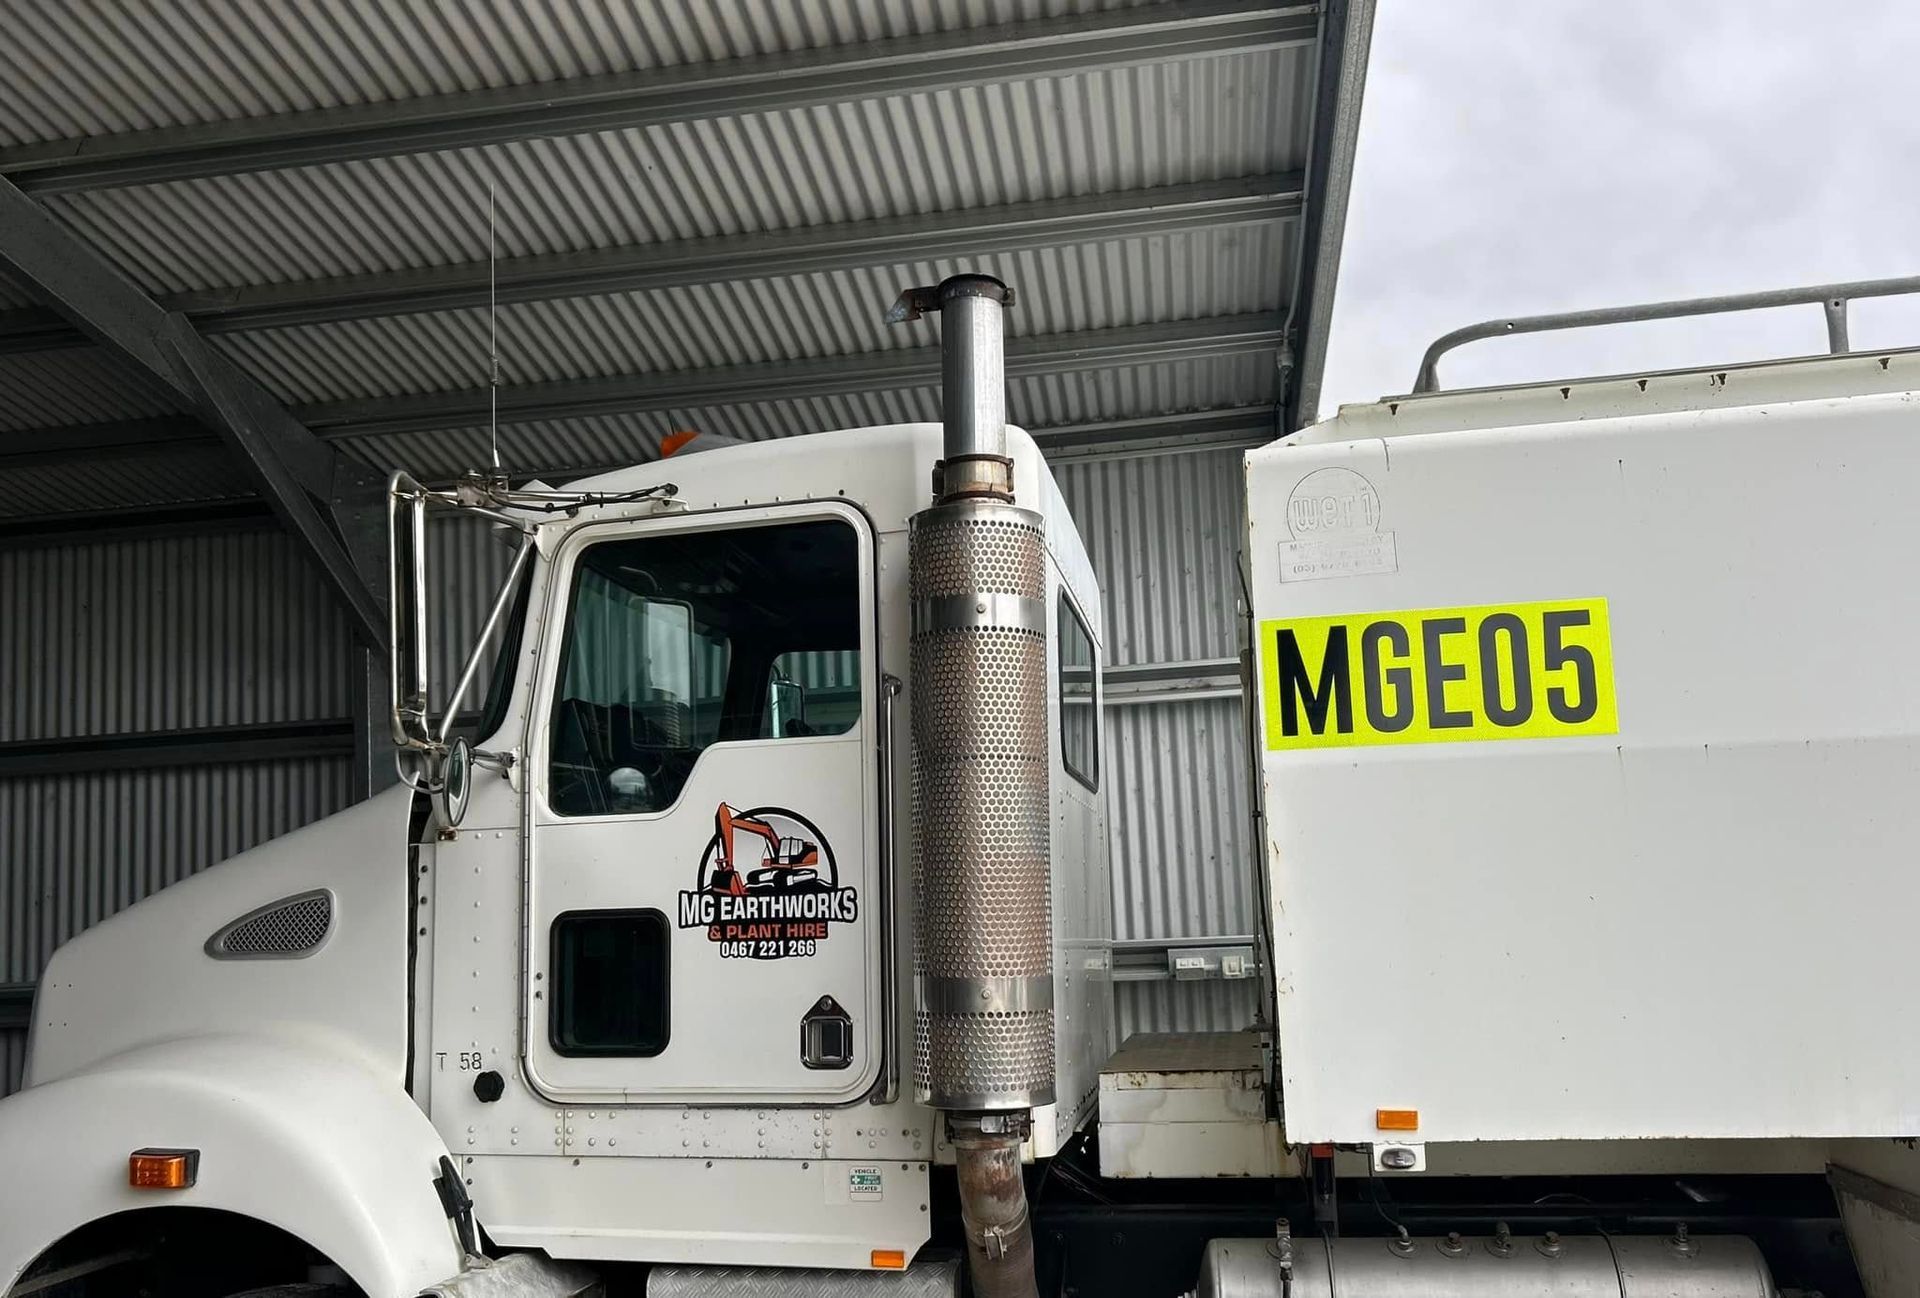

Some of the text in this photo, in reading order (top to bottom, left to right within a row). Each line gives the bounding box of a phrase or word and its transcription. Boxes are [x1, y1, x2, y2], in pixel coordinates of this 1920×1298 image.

[1276, 609, 1598, 737] MGE05
[680, 889, 857, 926] MG EARTHWORKS
[709, 923, 826, 939] & PLANT HIRE
[721, 940, 815, 957] 0467 221 266
[435, 1052, 482, 1072] T 58
